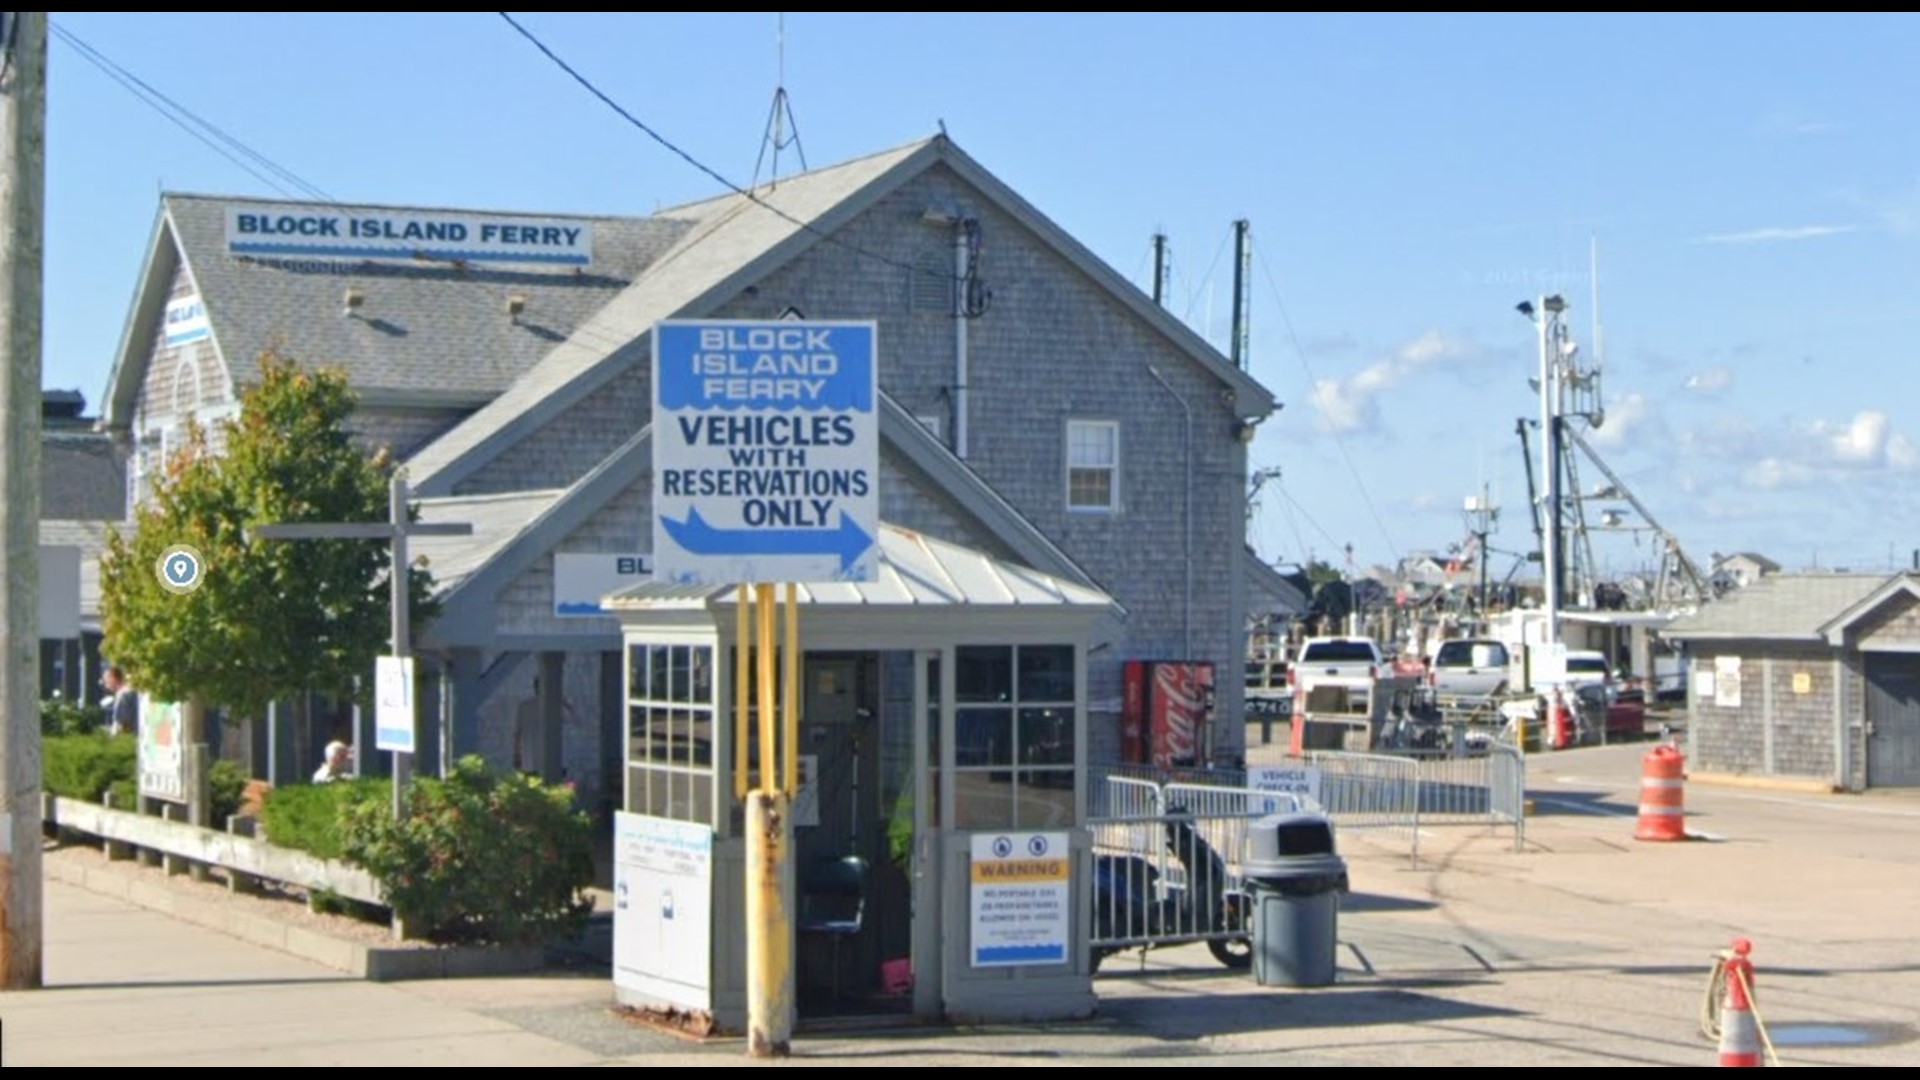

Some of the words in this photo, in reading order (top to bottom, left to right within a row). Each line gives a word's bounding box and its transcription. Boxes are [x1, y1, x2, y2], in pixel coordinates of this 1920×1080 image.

[237, 214, 340, 237] BLOCK
[350, 219, 468, 242] ISLAND
[480, 225, 581, 247] FERRY
[701, 329, 832, 351] BLOCK
[692, 354, 838, 376] ISLAND
[704, 379, 826, 400] FERRY
[678, 416, 855, 446] VEHICLES
[729, 449, 806, 467] WITH
[663, 470, 869, 497] RESERVATIONS
[743, 499, 834, 527] ONLY
[1261, 770, 1306, 781] VEHICLE
[981, 862, 1060, 877] WARNING
